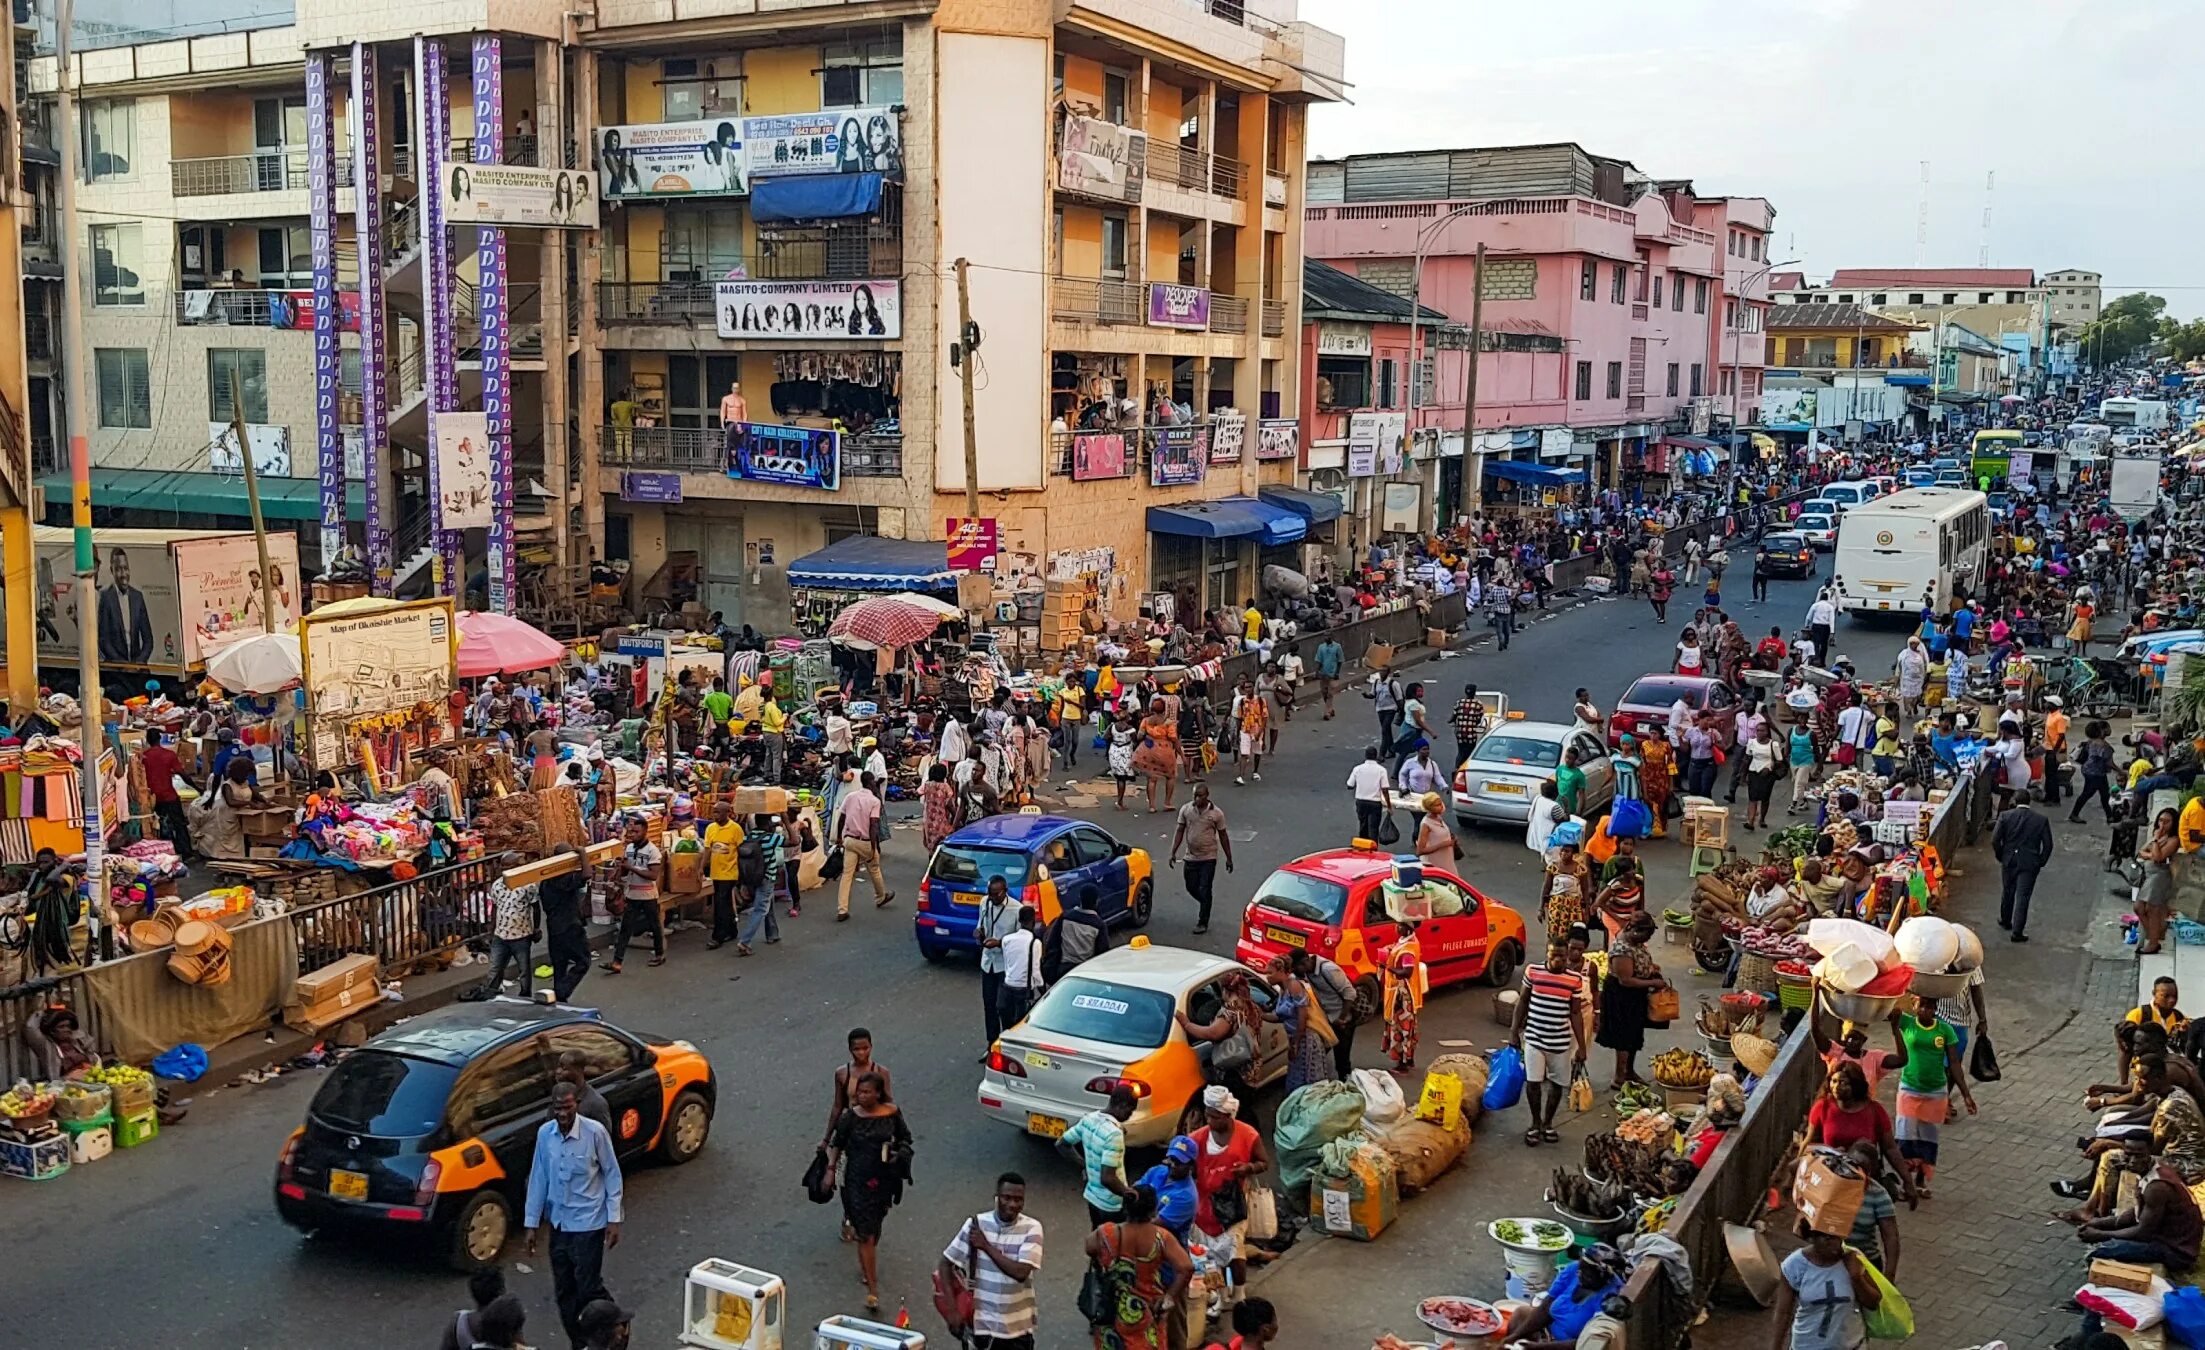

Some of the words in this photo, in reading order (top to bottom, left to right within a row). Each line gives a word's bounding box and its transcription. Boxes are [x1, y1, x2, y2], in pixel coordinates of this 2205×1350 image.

[476, 170, 504, 178] MASITO
[506, 172, 550, 180] ENTERPRISE
[472, 178, 500, 186] MASITO
[504, 179, 538, 188] COMPANY
[960, 523, 978, 534] 4G
[330, 626, 347, 634] Map
[348, 622, 356, 630] of
[394, 614, 420, 624] Market
[620, 638, 654, 648] KNUTSFORD
[1442, 941, 1462, 952] PFLEGE
[1086, 998, 1126, 1013] SHADDAI
